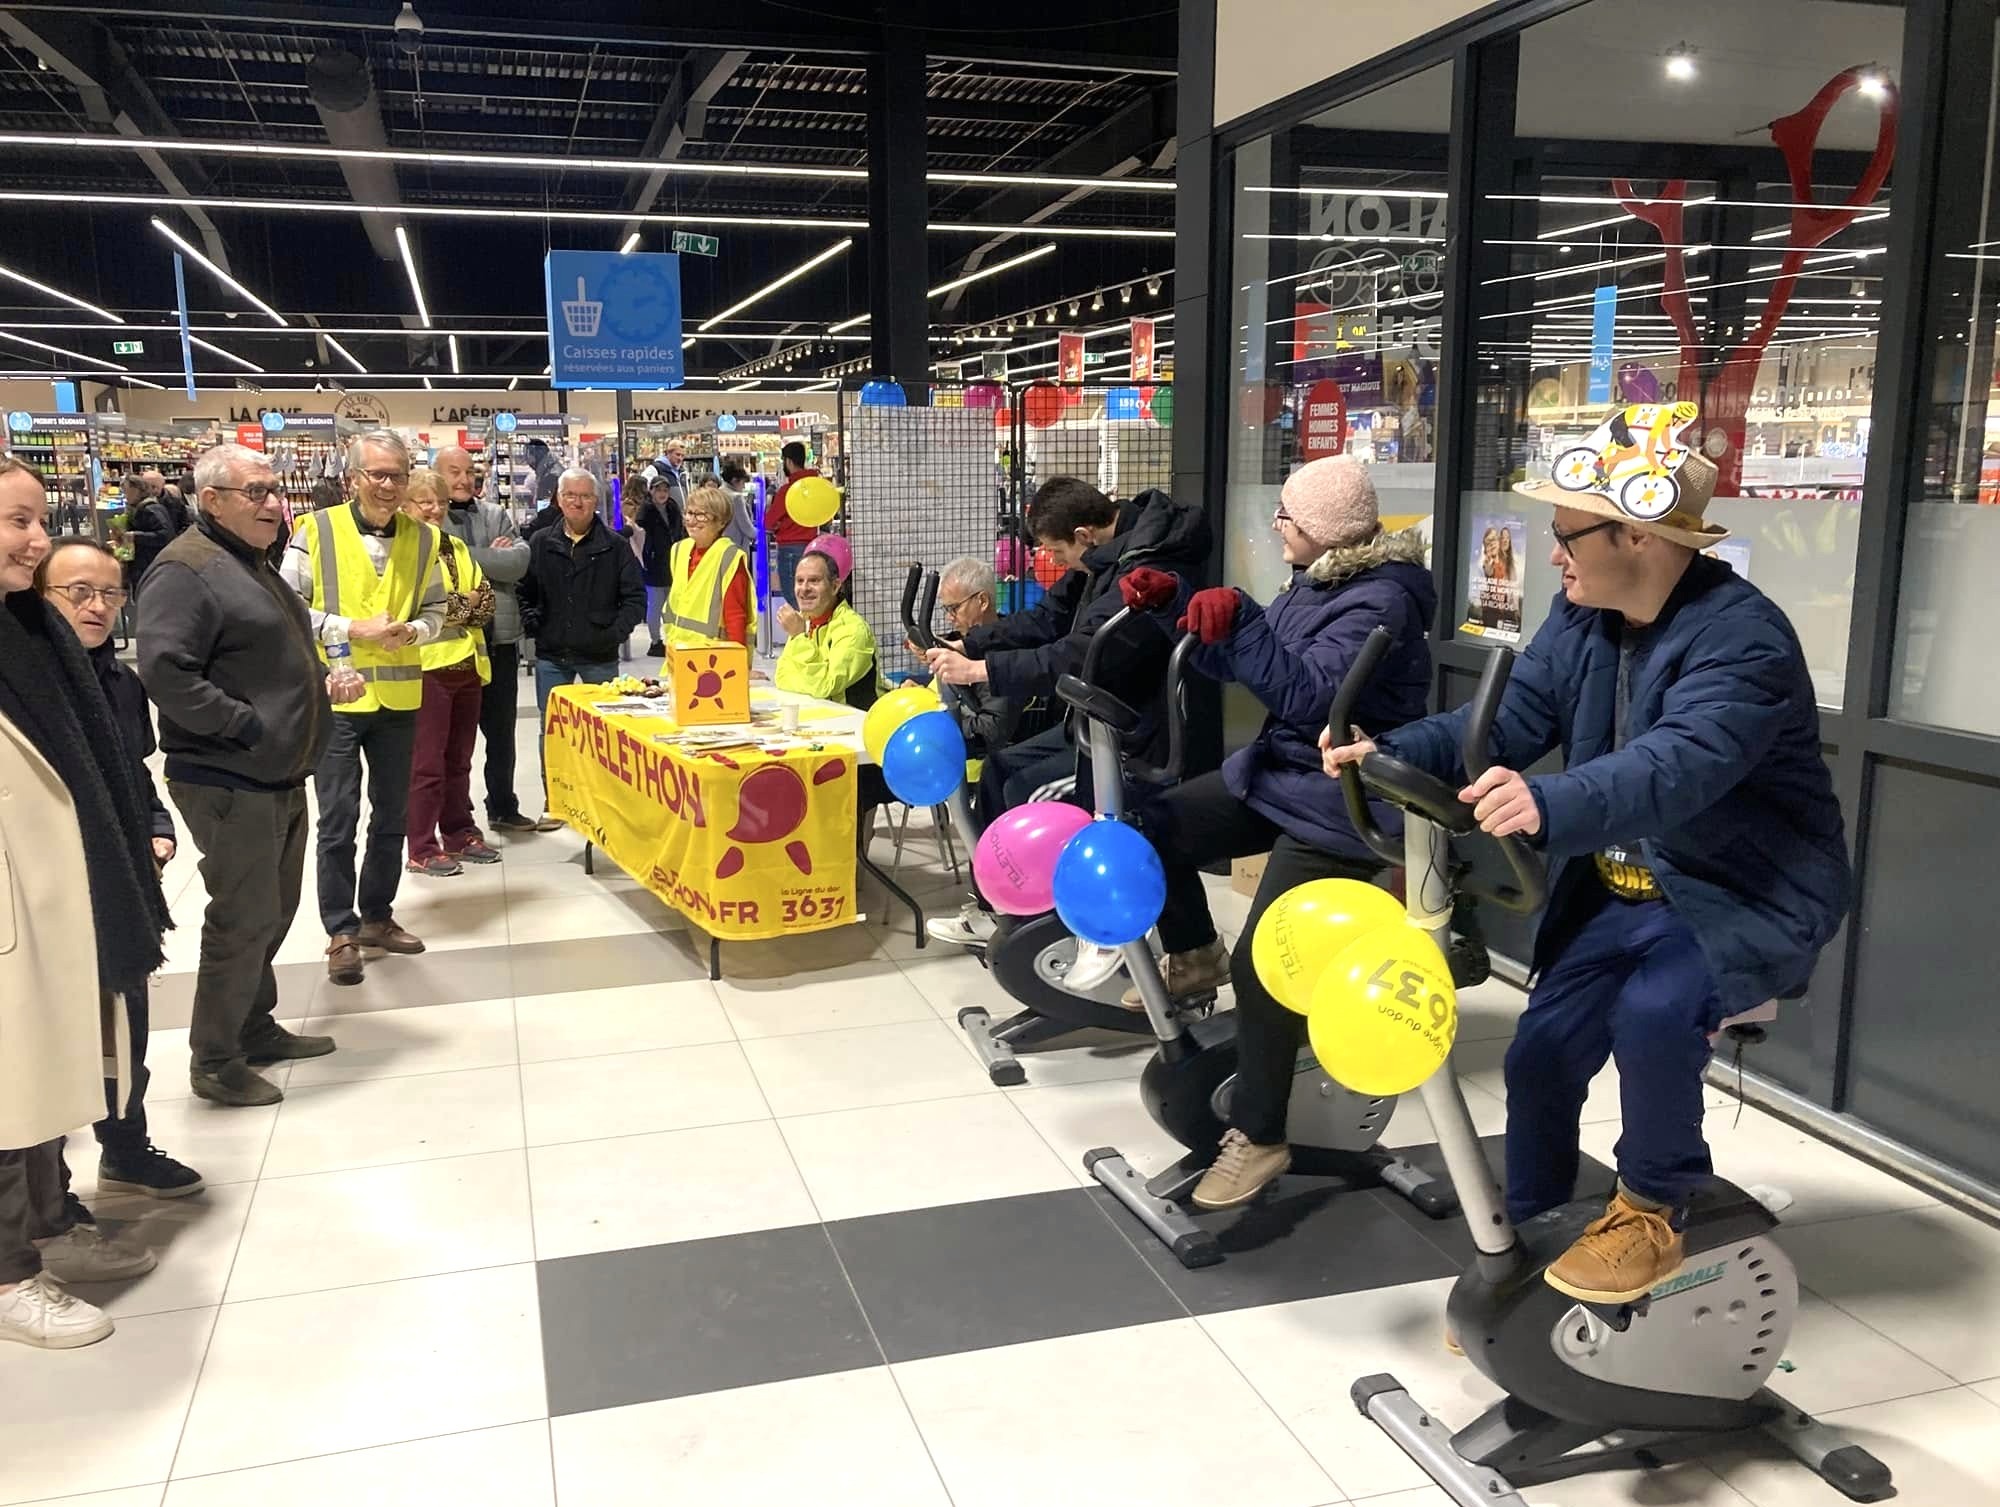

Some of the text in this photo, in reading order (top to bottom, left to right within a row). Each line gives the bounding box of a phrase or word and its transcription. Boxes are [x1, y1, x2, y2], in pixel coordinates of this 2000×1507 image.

[563, 345, 675, 364] Caisses rapides
[617, 365, 634, 373] aux
[637, 363, 675, 375] paniers
[230, 407, 252, 422] LA
[633, 406, 700, 423] HYGIÈNE
[1309, 402, 1339, 416] FEMMES
[1308, 419, 1339, 433] HOMMES
[1307, 436, 1338, 449] ENFANTS
[1377, 1004, 1404, 1022] don
[1405, 1017, 1422, 1031] du
